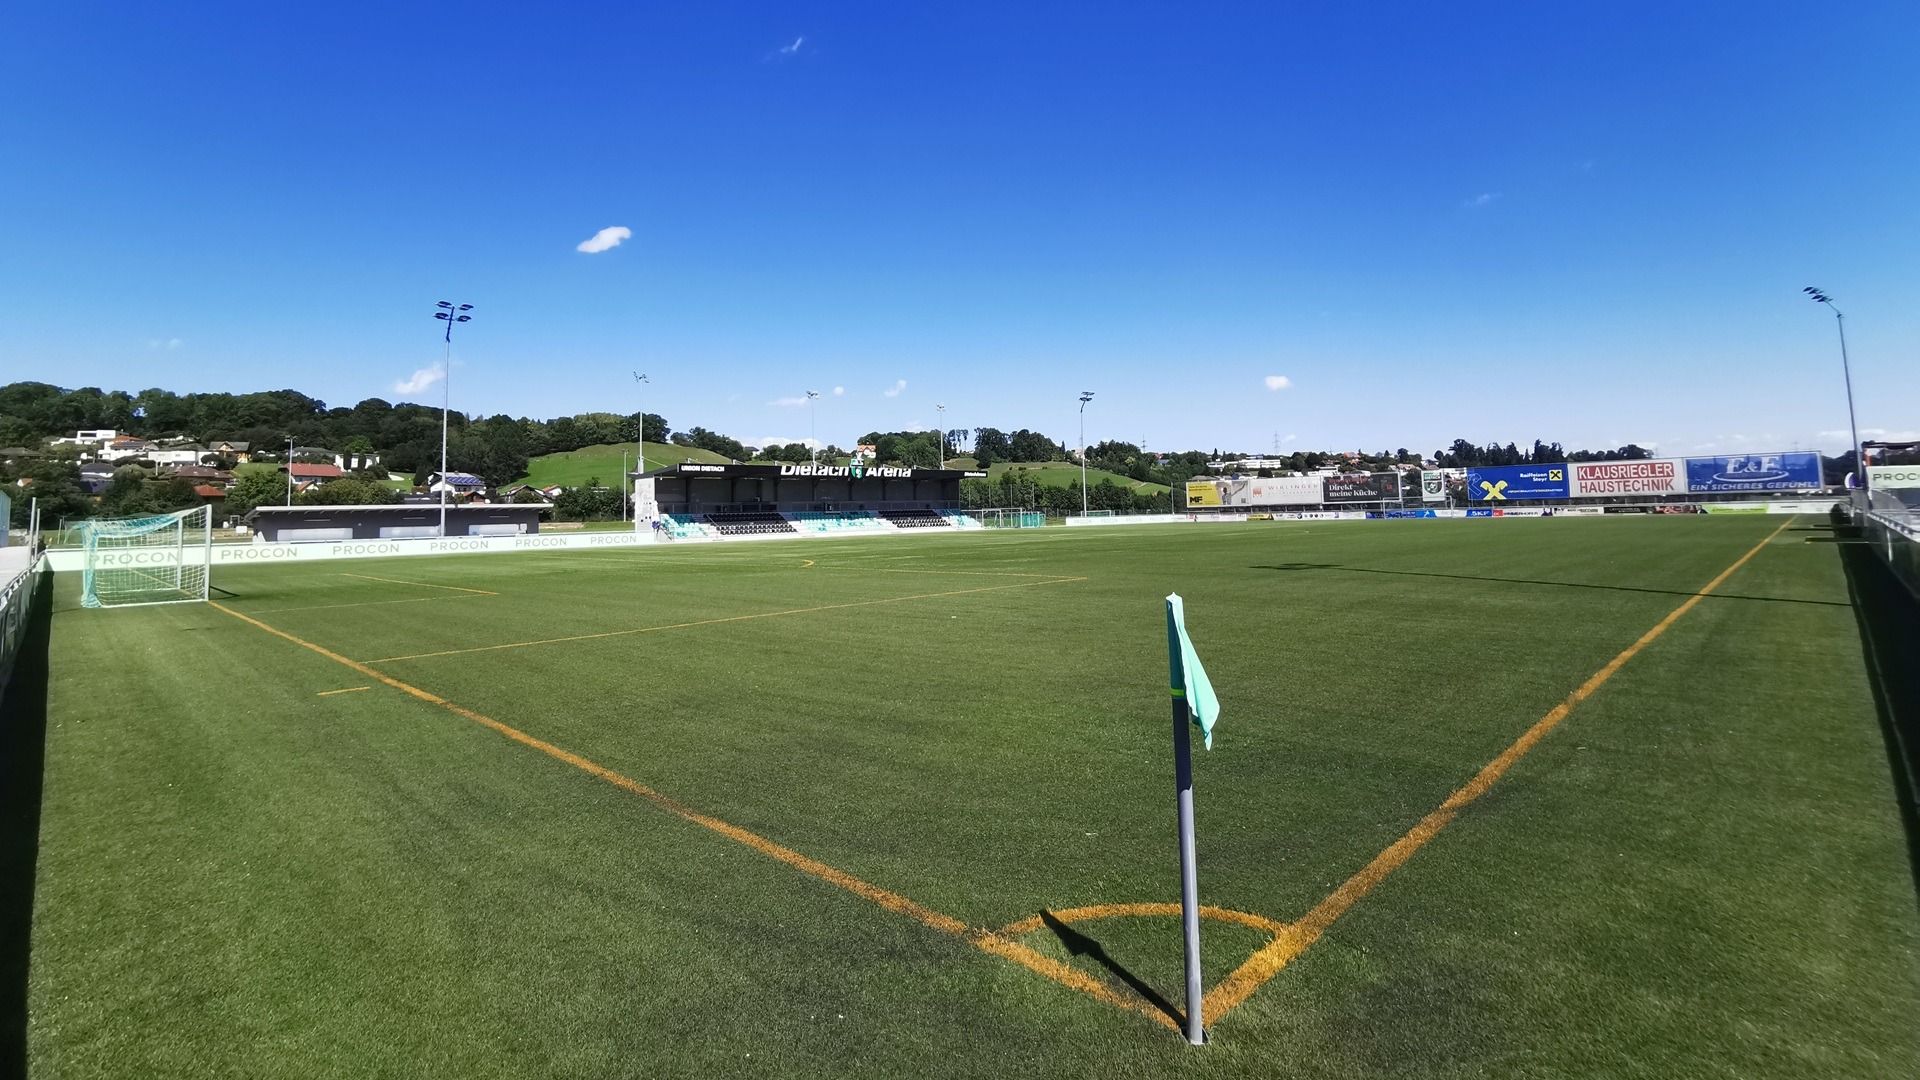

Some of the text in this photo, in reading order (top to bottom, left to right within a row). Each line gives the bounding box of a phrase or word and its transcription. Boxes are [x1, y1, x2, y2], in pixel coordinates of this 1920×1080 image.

[780, 465, 912, 478] Dietach Arena
[1578, 464, 1674, 480] KLAUSRIEGLER
[1872, 472, 1920, 482] PROC
[1579, 478, 1675, 494] HAUSTECHNIK
[1711, 482, 1763, 491] SICHERES
[1353, 489, 1379, 497] Küche
[89, 535, 637, 566] PROCON PROCON PROCON PROCON PROCON PROCON
